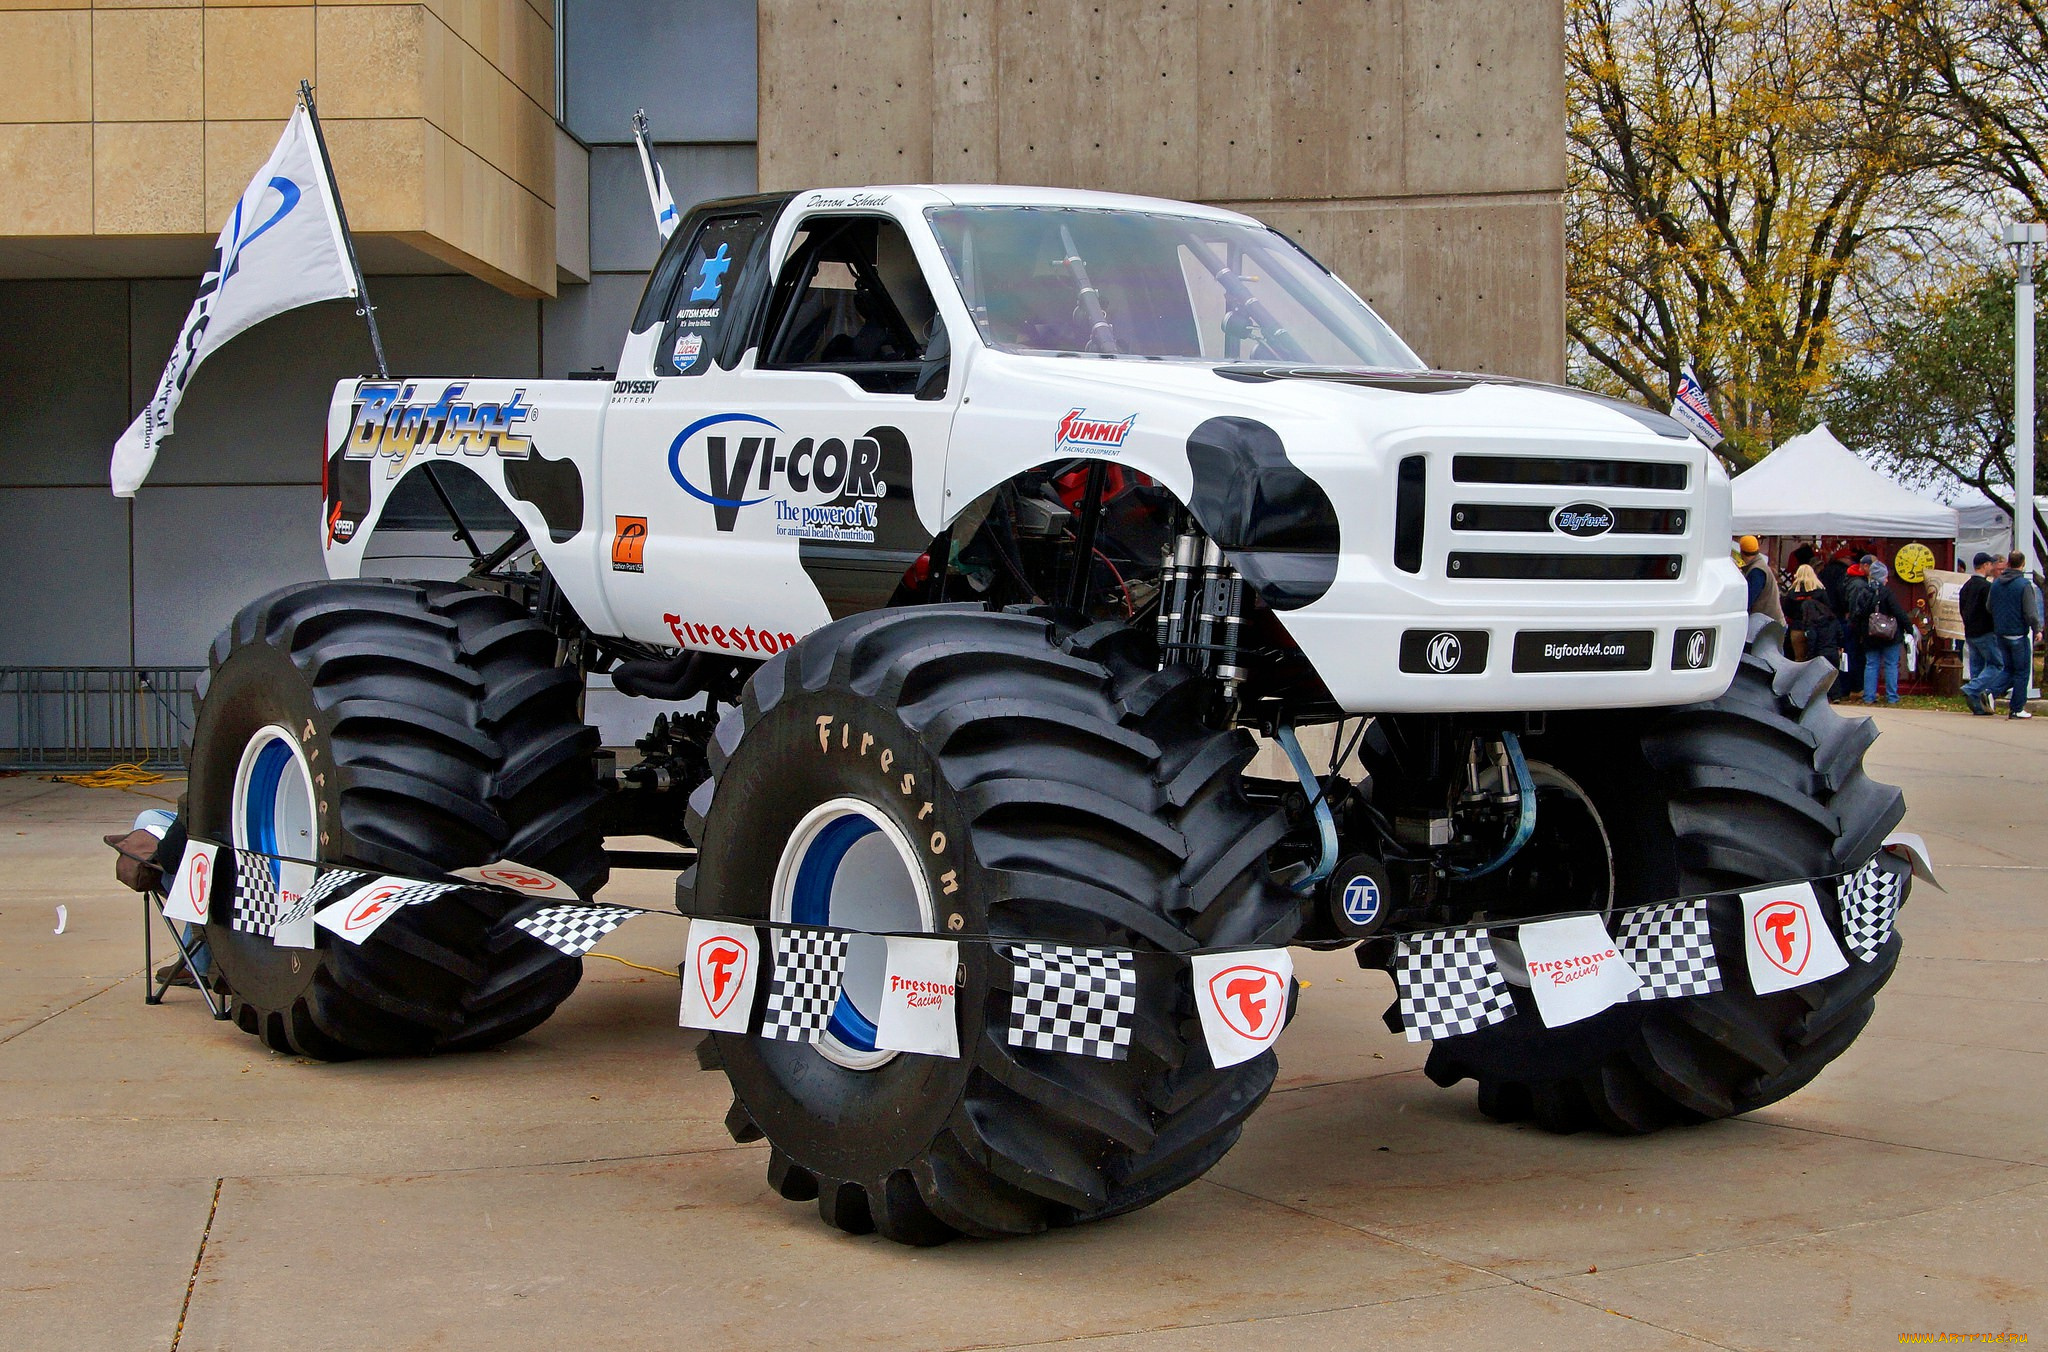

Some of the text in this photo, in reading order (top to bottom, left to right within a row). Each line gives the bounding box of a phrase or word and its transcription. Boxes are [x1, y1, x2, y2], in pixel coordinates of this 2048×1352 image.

[807, 193, 893, 208] Darron Schnell
[676, 308, 720, 319] AUTISM SPEAKS
[677, 344, 700, 354] LUCAS
[613, 380, 660, 394] ODYSSEY
[344, 381, 533, 480] Bigfoot
[1677, 405, 1715, 440] Secure. Smart.
[1063, 446, 1121, 456] RACING EQUIPMENT
[774, 499, 800, 522] The
[801, 507, 844, 529] power
[845, 502, 863, 526] of
[1559, 512, 1609, 531] Bigfoot
[335, 519, 354, 535] SPEED
[776, 525, 874, 542] for animal health & nutrition
[663, 613, 797, 655] Fireston
[1431, 636, 1457, 670] KC
[1544, 643, 1625, 660] Bigfoot4x4.com
[1688, 633, 1704, 665] KC
[302, 718, 329, 846] Fires
[815, 714, 965, 931] Firestone
[1346, 885, 1377, 915] ZF
[1528, 949, 1616, 977] Firestone
[890, 975, 955, 996] Firestone
[1551, 963, 1600, 988] Racing
[906, 991, 943, 1010] Racing
